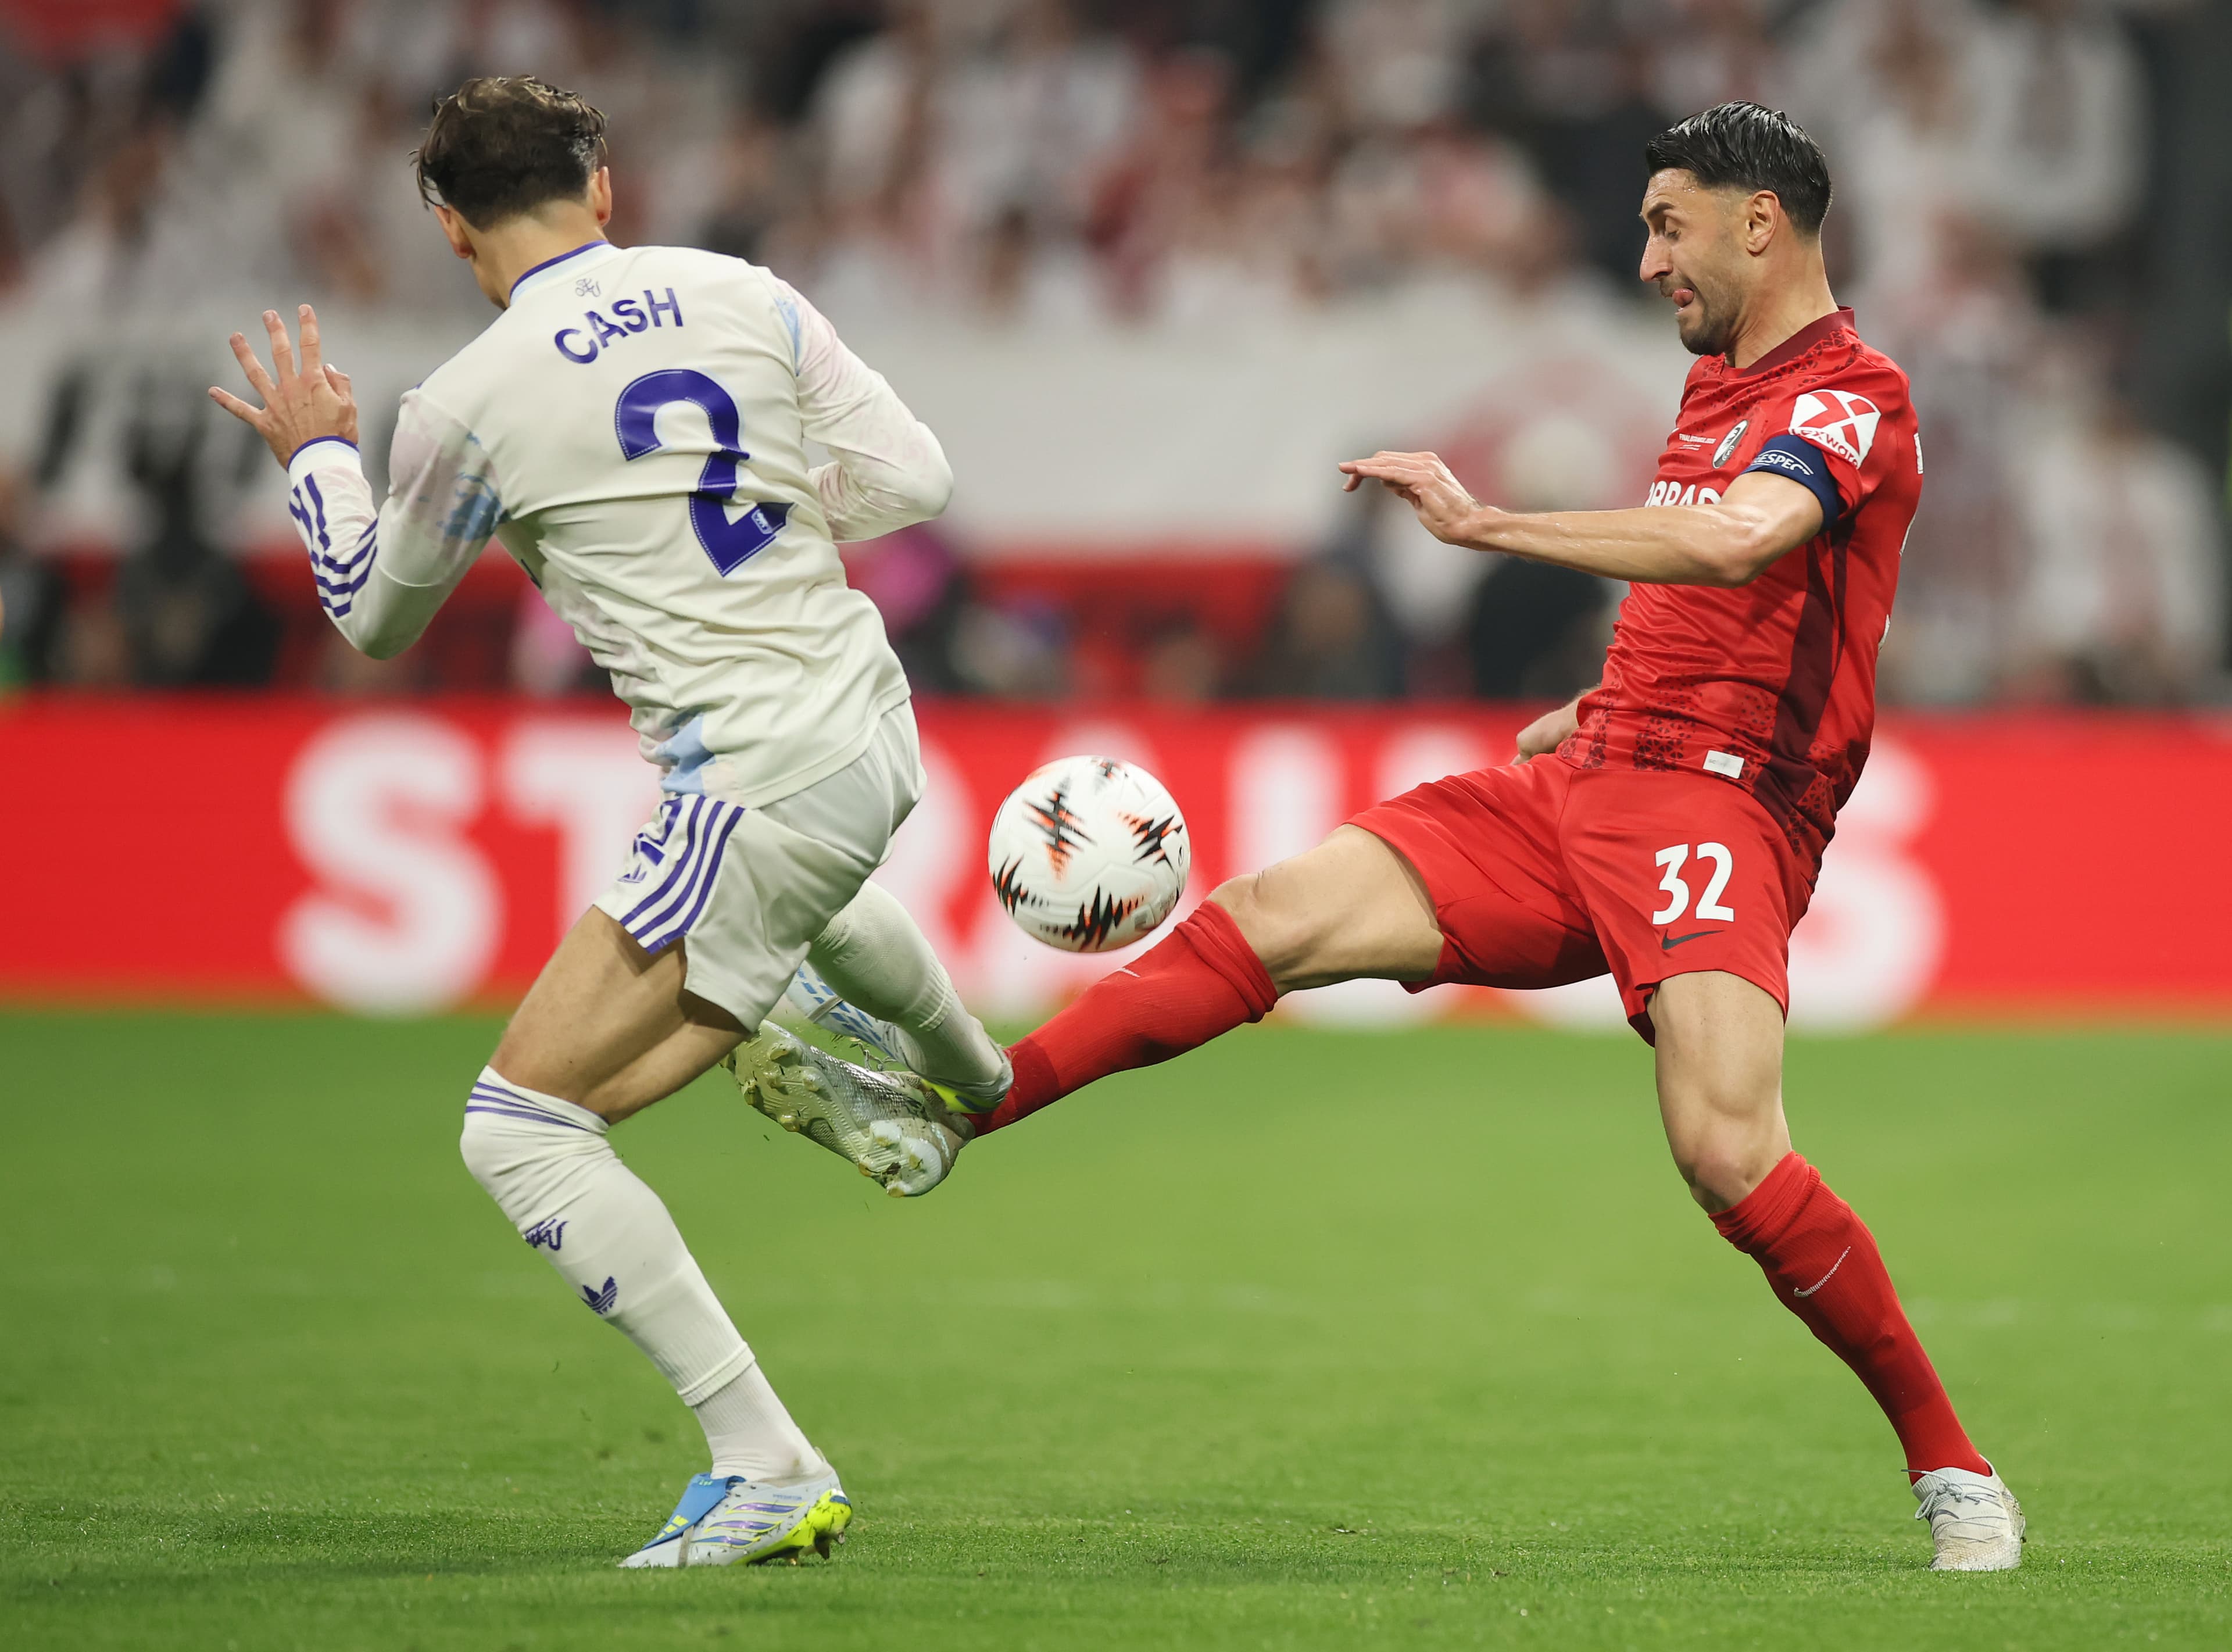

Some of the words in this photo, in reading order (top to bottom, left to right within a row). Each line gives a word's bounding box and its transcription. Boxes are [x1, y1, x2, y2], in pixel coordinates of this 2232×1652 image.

[554, 288, 684, 364] CASH
[614, 369, 795, 577] 2
[1651, 841, 1735, 925] 32
